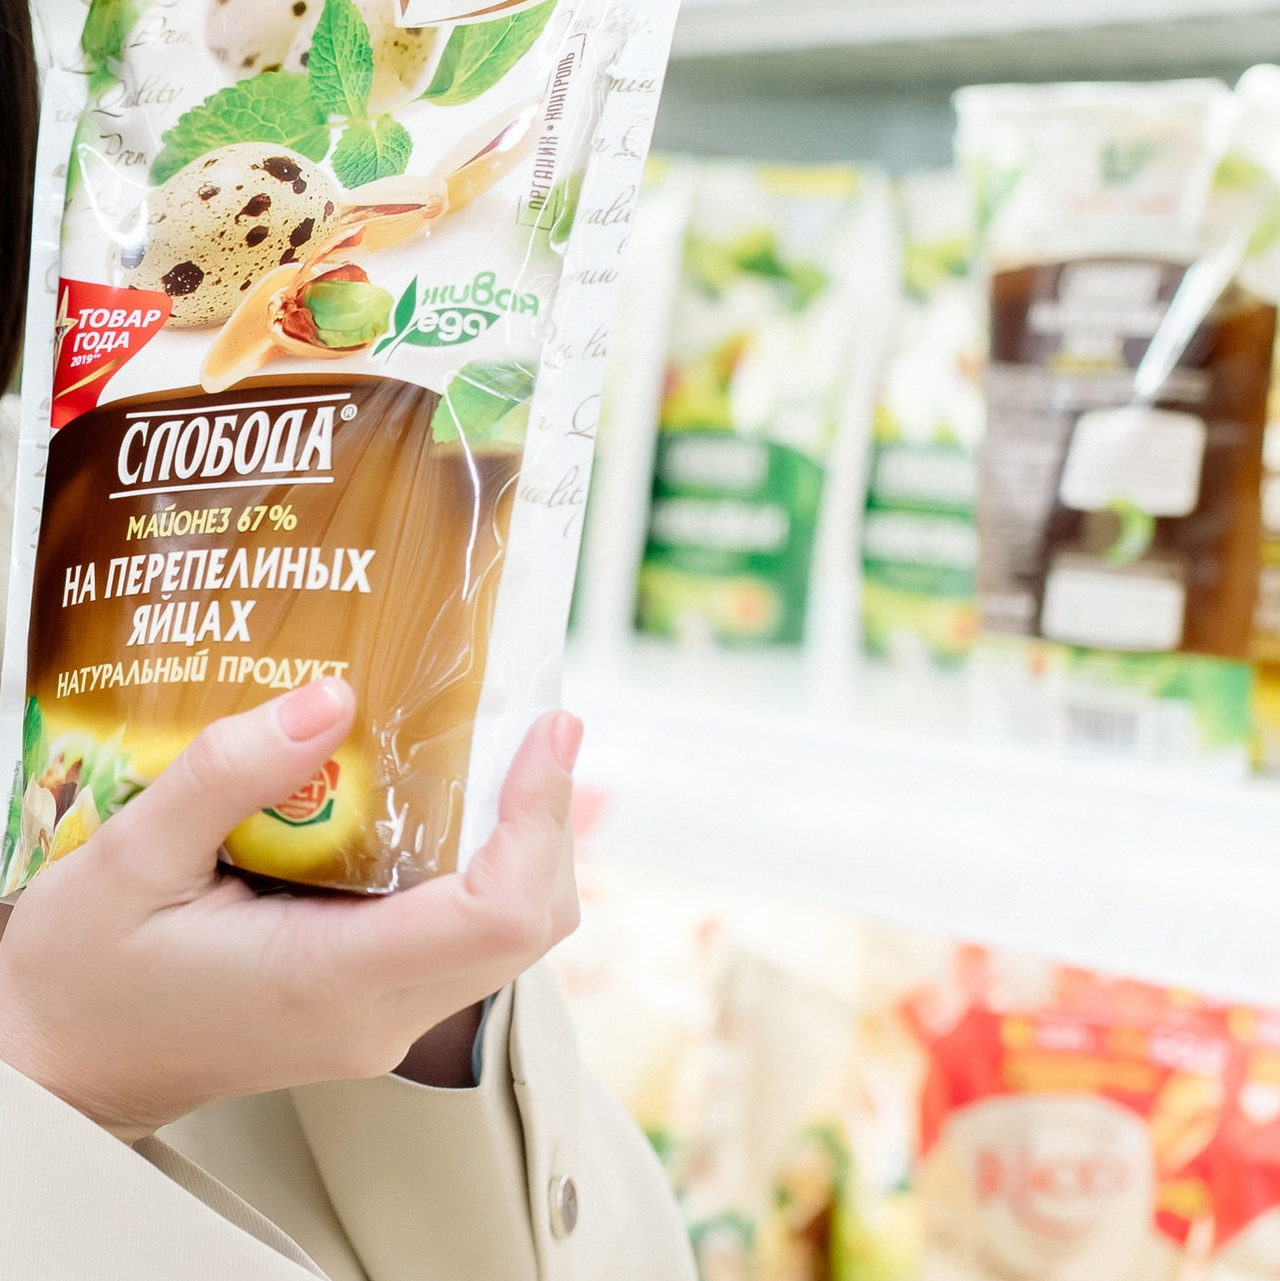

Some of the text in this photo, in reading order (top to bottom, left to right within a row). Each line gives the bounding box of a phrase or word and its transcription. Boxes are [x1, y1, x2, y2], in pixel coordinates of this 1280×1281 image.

[528, 51, 576, 212] ОРГАНИК КОНТРОЛЬ
[72, 331, 130, 353] ГОДА
[77, 308, 162, 330] ТОВАР
[126, 503, 298, 541] МАЙОНЕЗ 67%
[62, 546, 376, 608] НА ПЕРЕПЕЛИНЫХ
[126, 593, 257, 647] ЯЙЦАХ
[56, 648, 210, 699] НАТУРАЛЬНЫЙ
